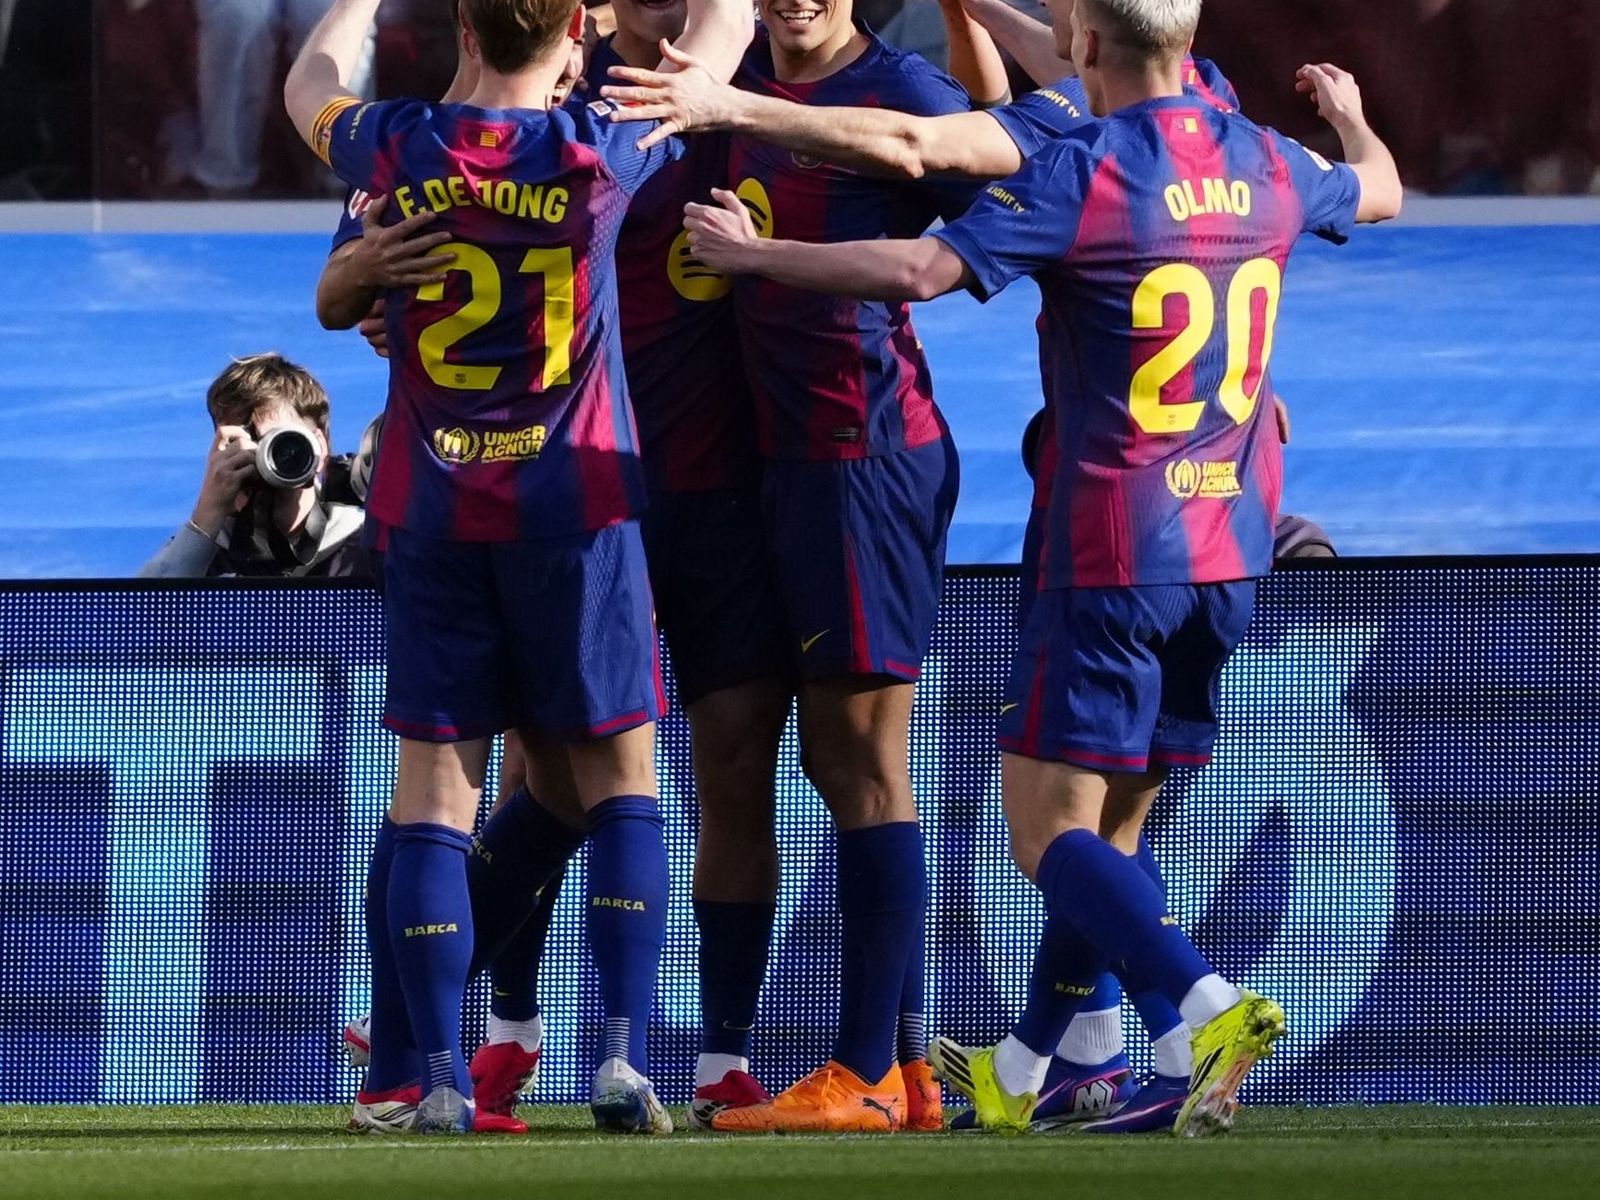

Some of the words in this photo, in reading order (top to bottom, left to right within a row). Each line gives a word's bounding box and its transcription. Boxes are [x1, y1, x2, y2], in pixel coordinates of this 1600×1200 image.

[474, 180, 569, 224] JONG
[1164, 178, 1251, 221] OLMO
[416, 242, 575, 391] 21
[1129, 257, 1281, 434] 20
[483, 425, 547, 447] UNHCR
